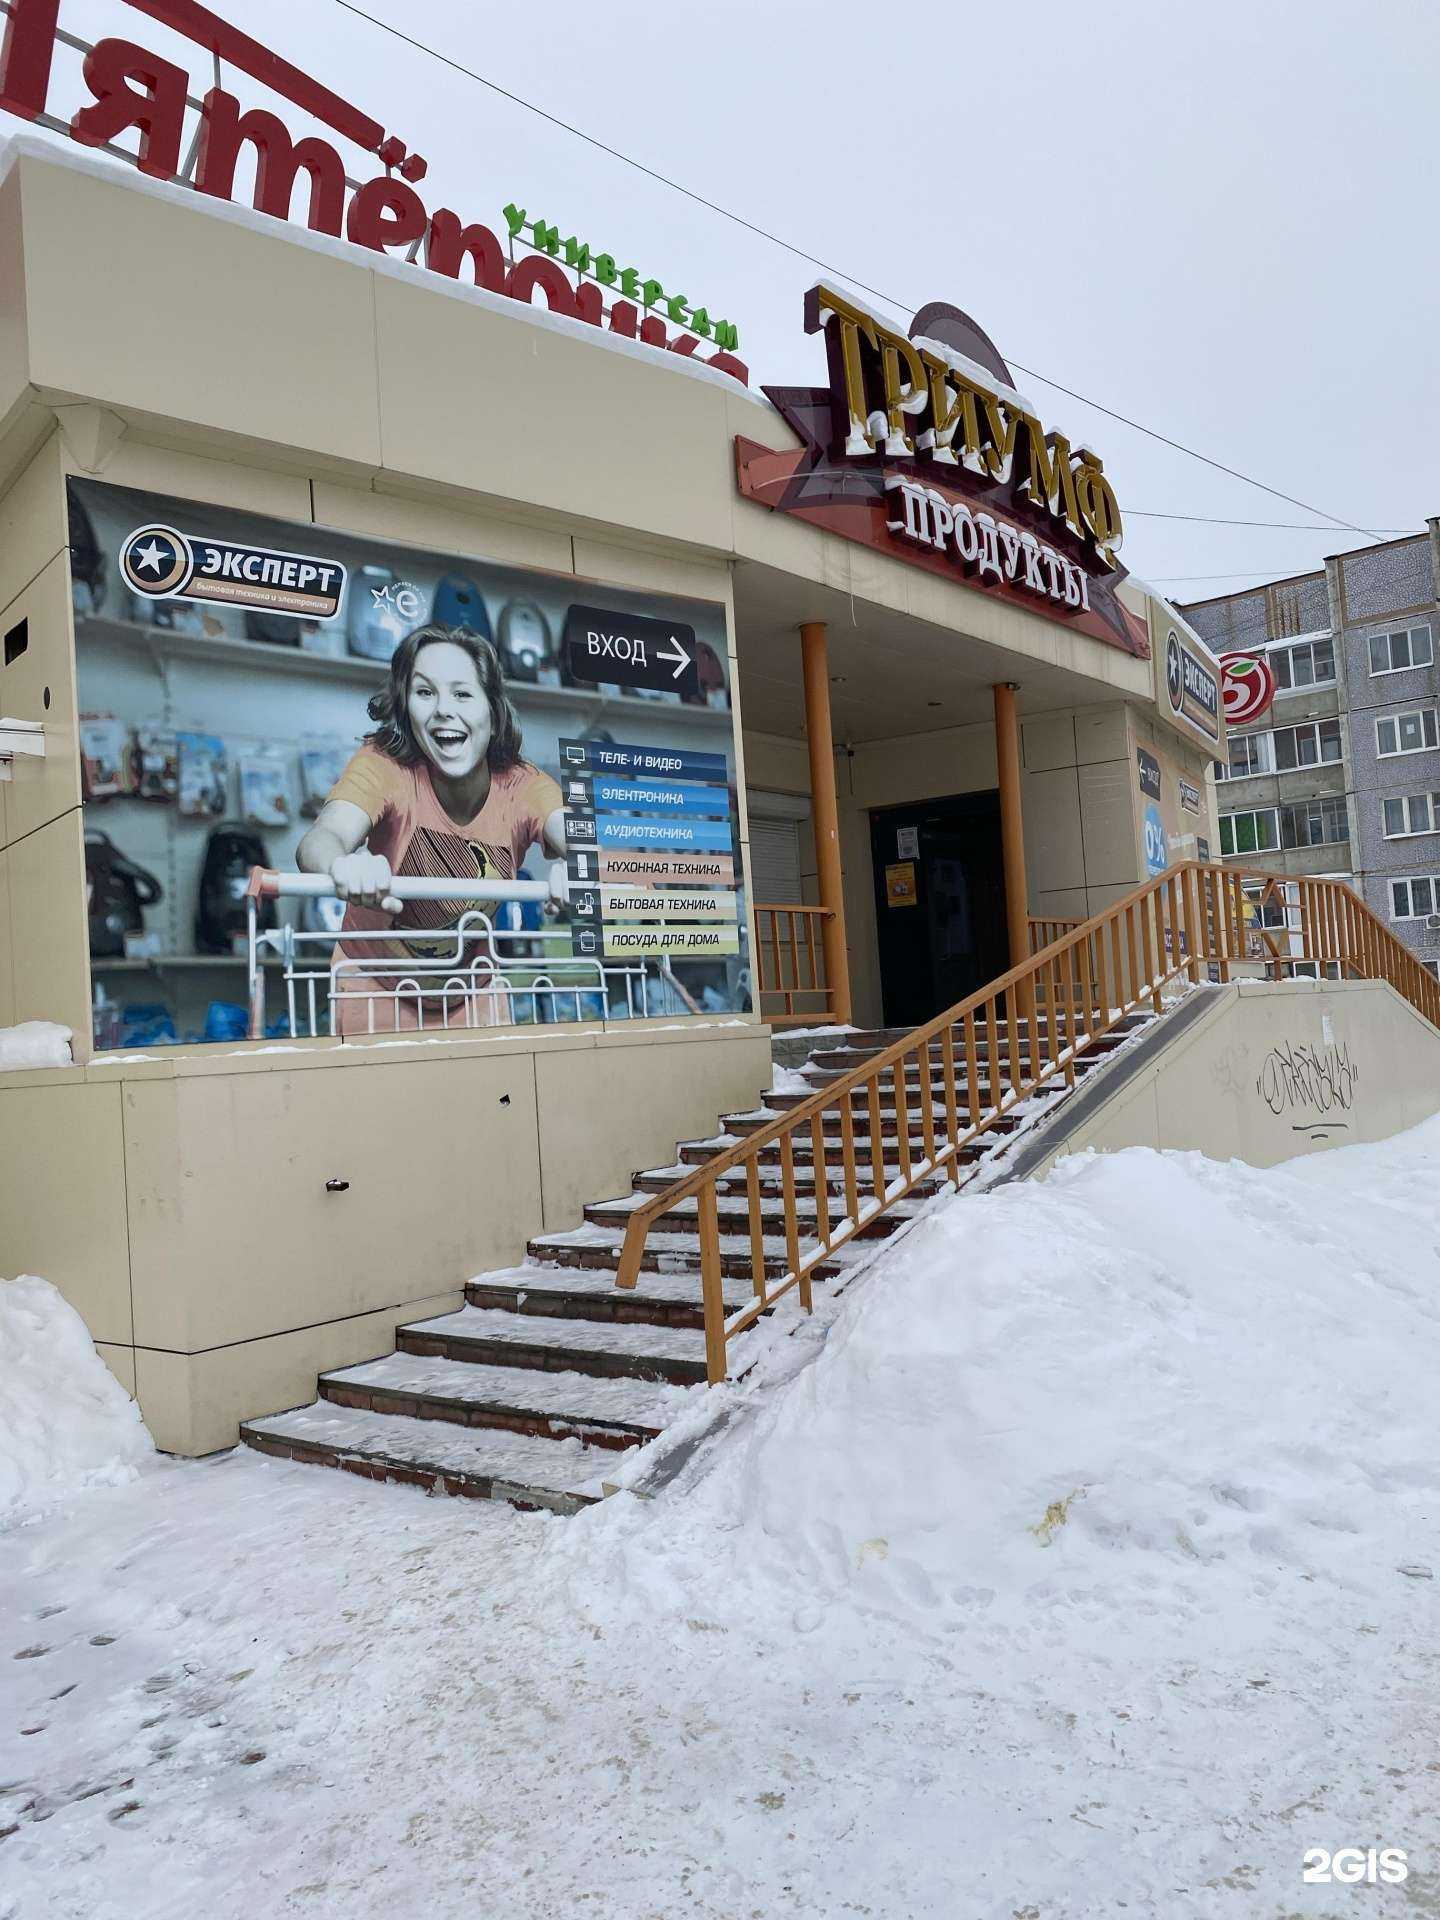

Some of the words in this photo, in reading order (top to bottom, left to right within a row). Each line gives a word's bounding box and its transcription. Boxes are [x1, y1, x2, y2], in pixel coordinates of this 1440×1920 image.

[502, 203, 739, 352] УНИВЕРСАМ
[804, 276, 1123, 577] ТРИУМФ
[895, 483, 1092, 613] ПРОДУКТЫ
[201, 548, 336, 592] ЭКСПЕРТ
[587, 631, 648, 667] ВХОД
[1184, 656, 1215, 712] ЭКСПЕРТ
[599, 751, 631, 766] ТЕЛЕ-
[633, 755, 642, 767] И
[645, 756, 682, 771] ВИДЕО
[601, 787, 685, 805] ЭЛЕКТРОНИКА
[603, 824, 694, 841] АУДИОТЕХНИКА
[607, 861, 669, 874] КУХОННАЯ
[672, 863, 721, 876] ТЕХНИКА
[609, 898, 665, 910] БЫТОВАЯ
[668, 899, 717, 911] ТЕХНИКА
[612, 934, 658, 948] ПОСУДА
[660, 934, 685, 948] ДЛЯ
[687, 934, 720, 948] ДОМА
